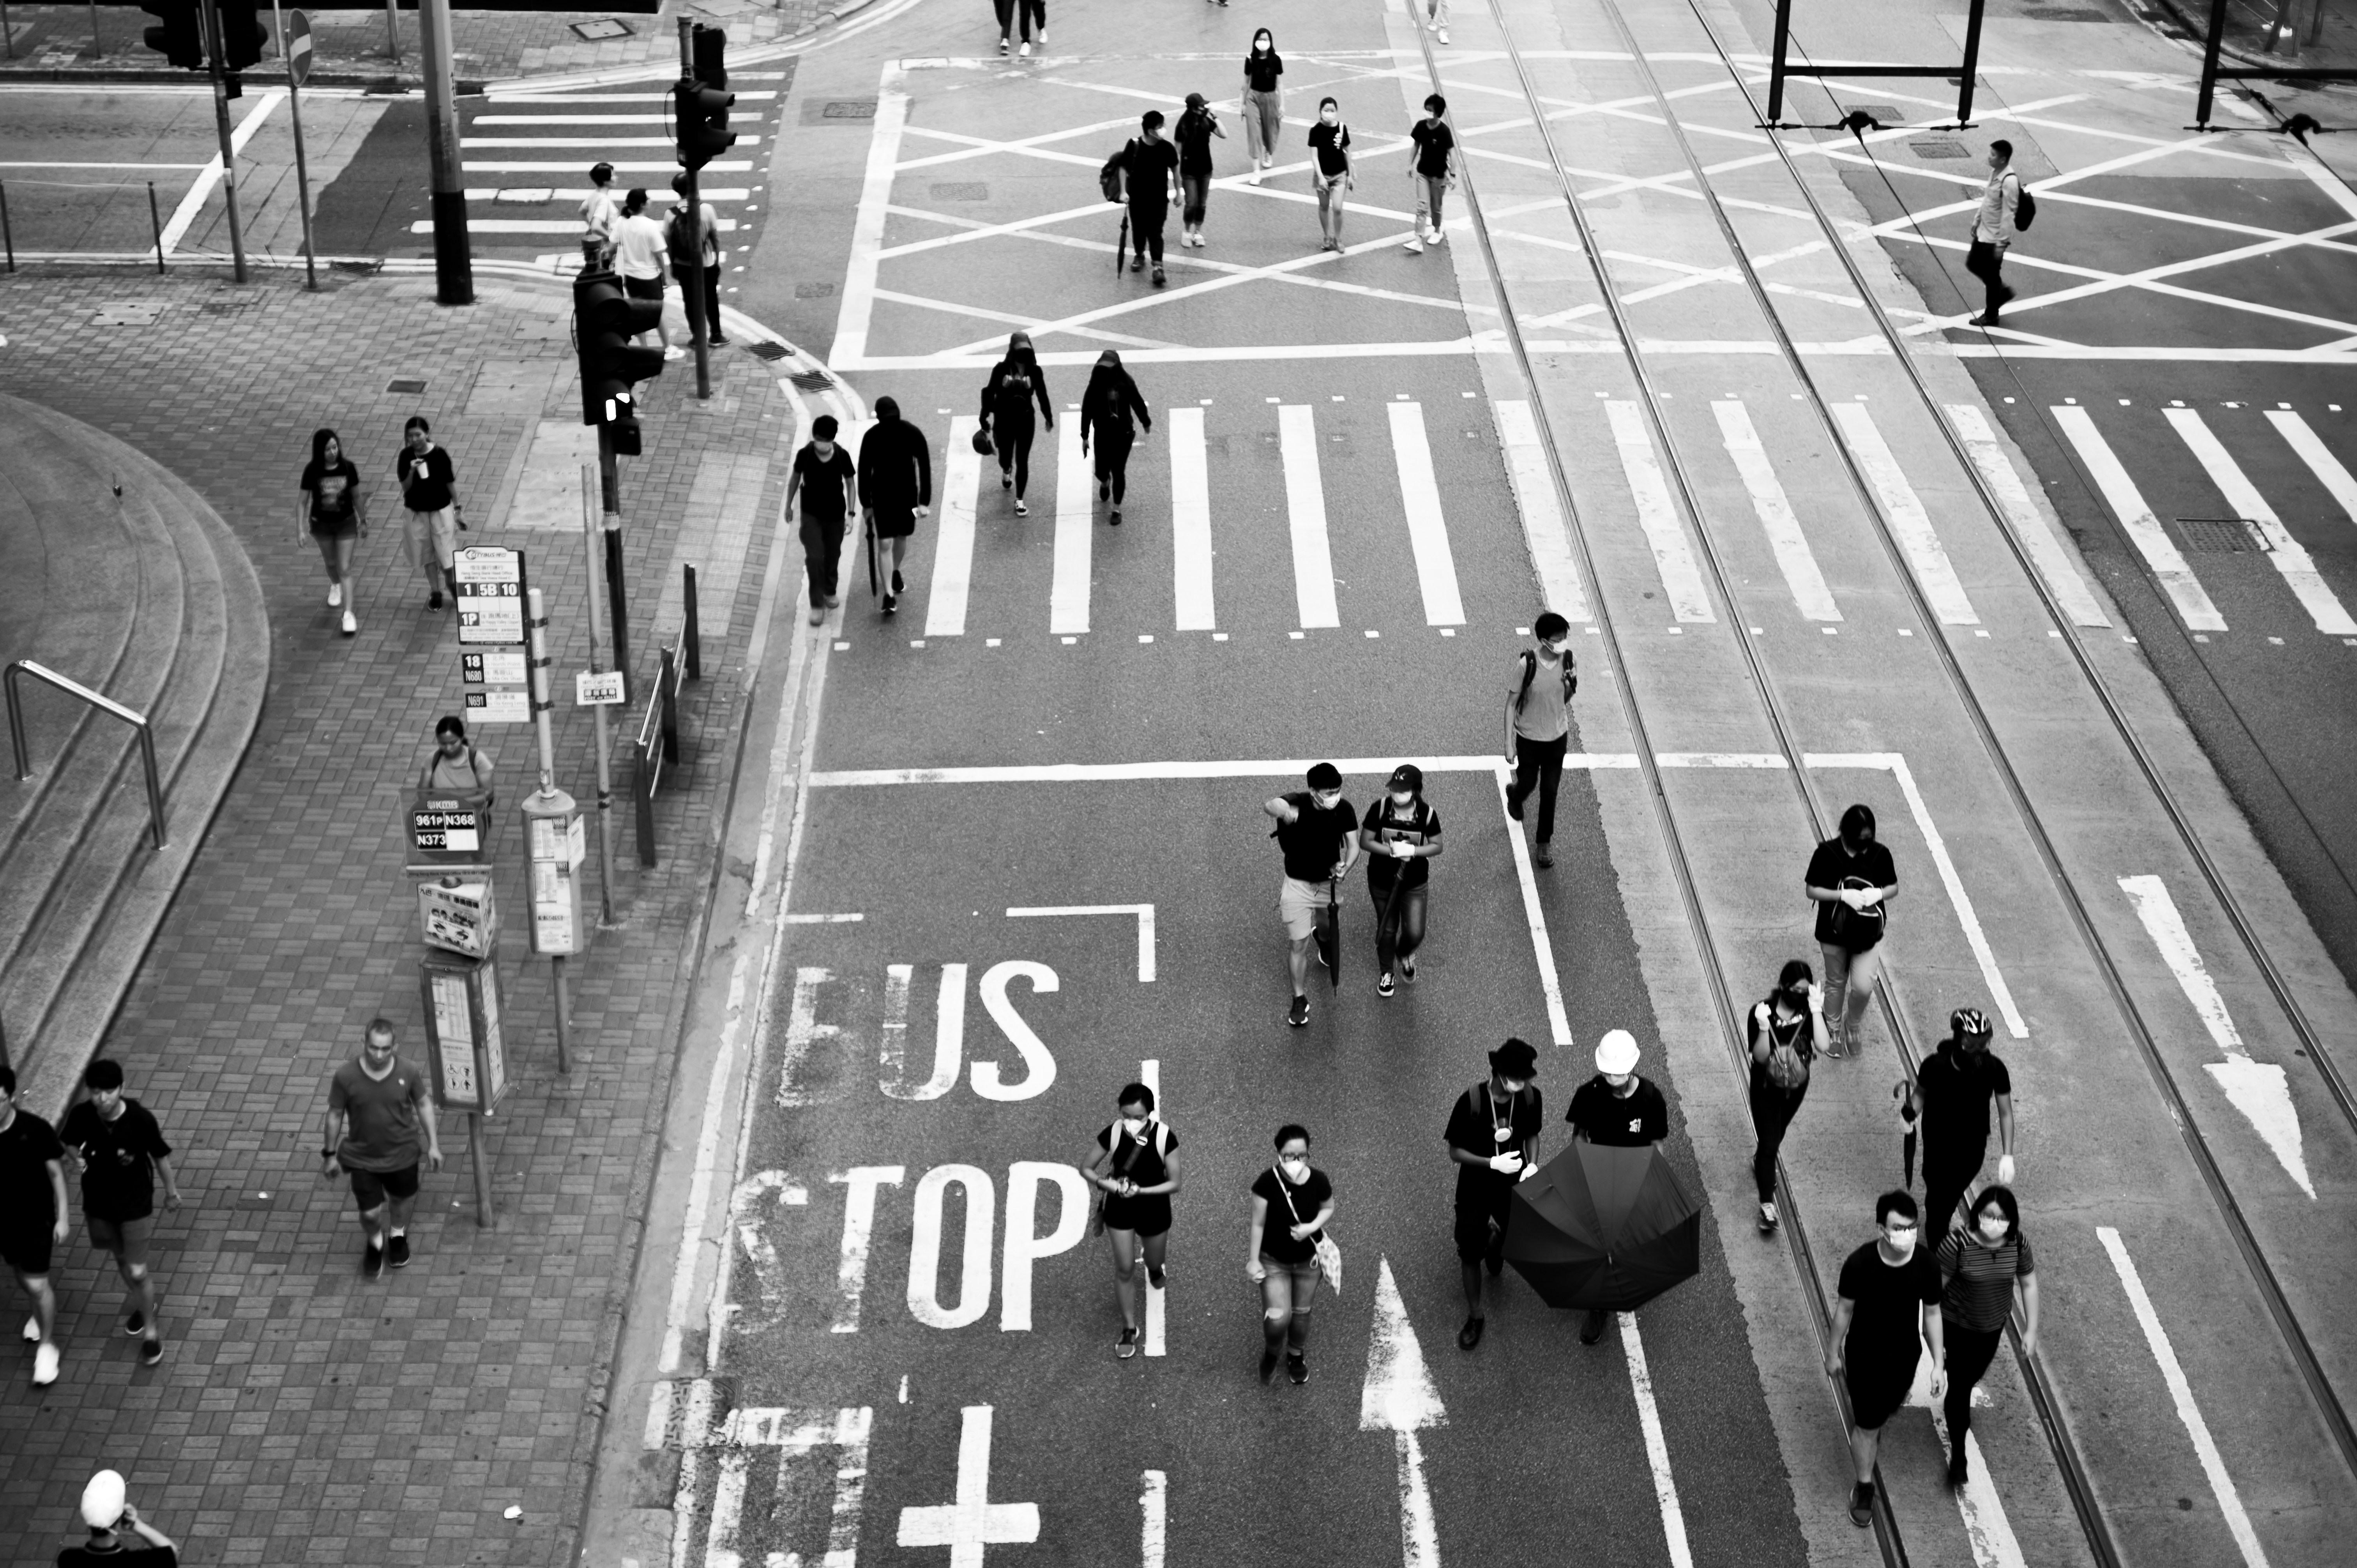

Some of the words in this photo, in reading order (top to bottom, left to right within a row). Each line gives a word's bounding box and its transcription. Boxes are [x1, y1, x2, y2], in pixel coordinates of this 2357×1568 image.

[464, 584, 472, 596] 1
[479, 583, 497, 596] 5B
[502, 583, 517, 596] 10
[462, 613, 477, 625] 1P
[465, 656, 481, 667] 18
[465, 671, 482, 681] N680
[468, 696, 484, 706] N691
[416, 814, 443, 826] 961P
[445, 814, 474, 826] N368
[417, 835, 446, 845] N373
